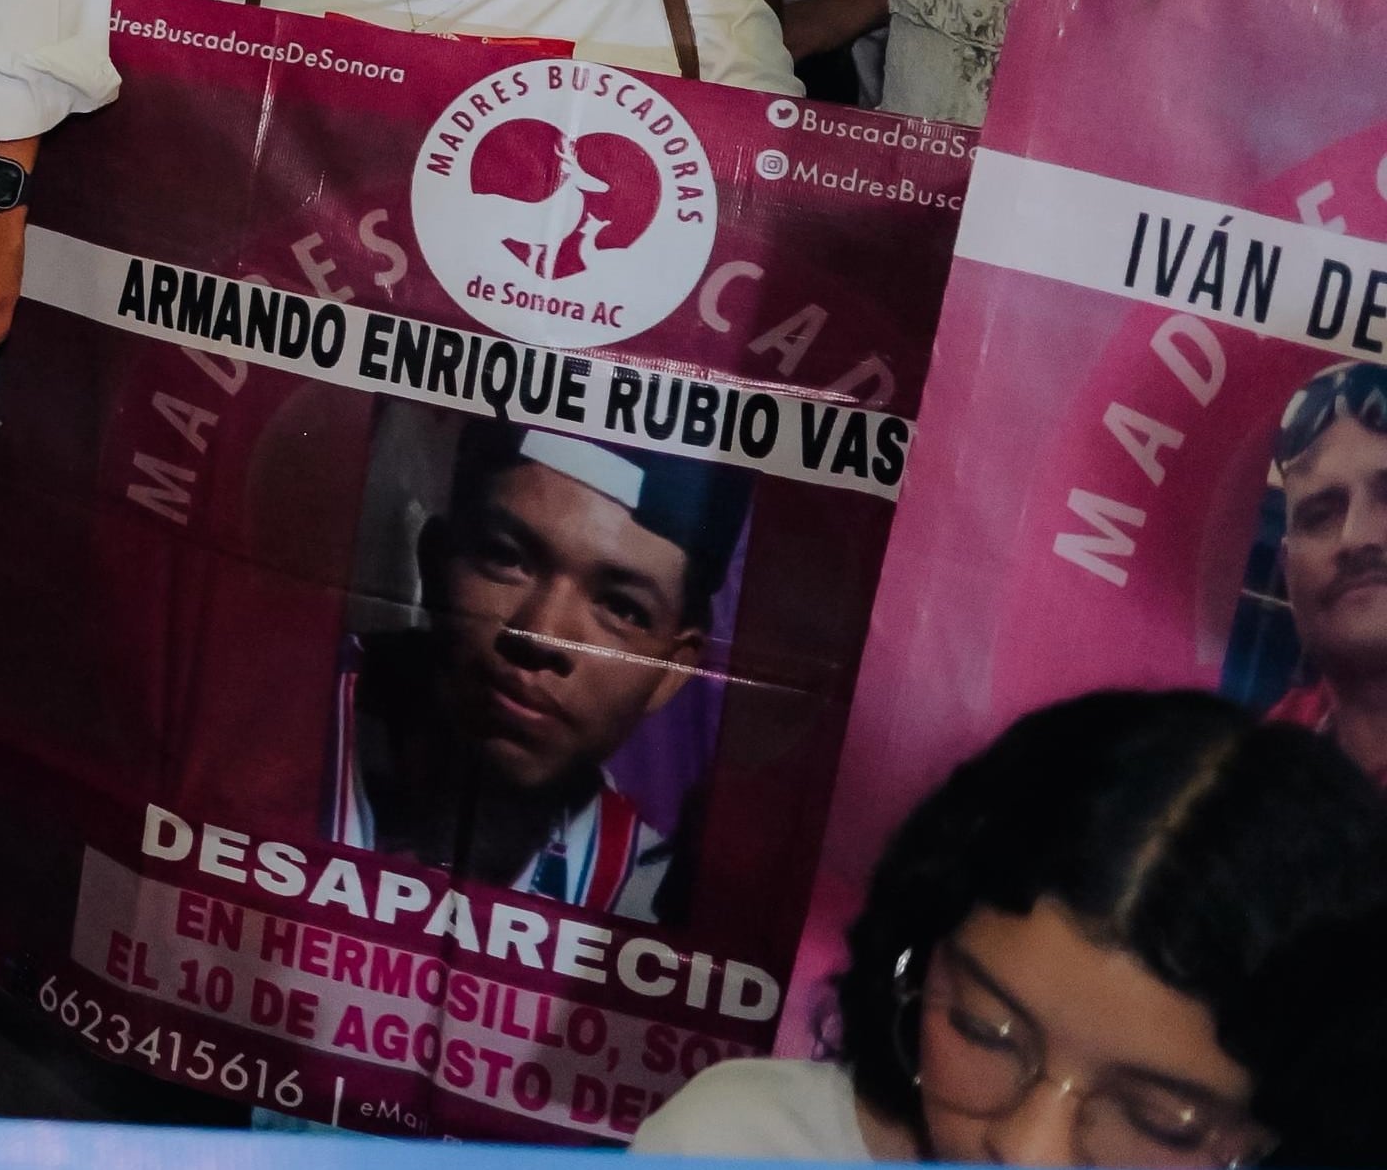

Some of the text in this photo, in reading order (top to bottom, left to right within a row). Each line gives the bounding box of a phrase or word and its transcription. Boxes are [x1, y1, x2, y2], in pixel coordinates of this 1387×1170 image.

[426, 65, 704, 225] MADRES BUSCADORAS
[466, 275, 625, 329] de Sonora AC
[1123, 212, 1284, 324] IVÁN
[117, 258, 911, 487] ARMANDO ENRIQUE RUBIO VAS
[140, 803, 781, 1023] DESAPARECID
[176, 891, 245, 952] EN
[260, 917, 620, 1073] HERMOSILLO,
[39, 975, 305, 1109] 6623415616
[105, 931, 160, 991] EL
[176, 958, 234, 1014] 10
[250, 979, 319, 1039] DE
[332, 1005, 553, 1112] AGOSTO
